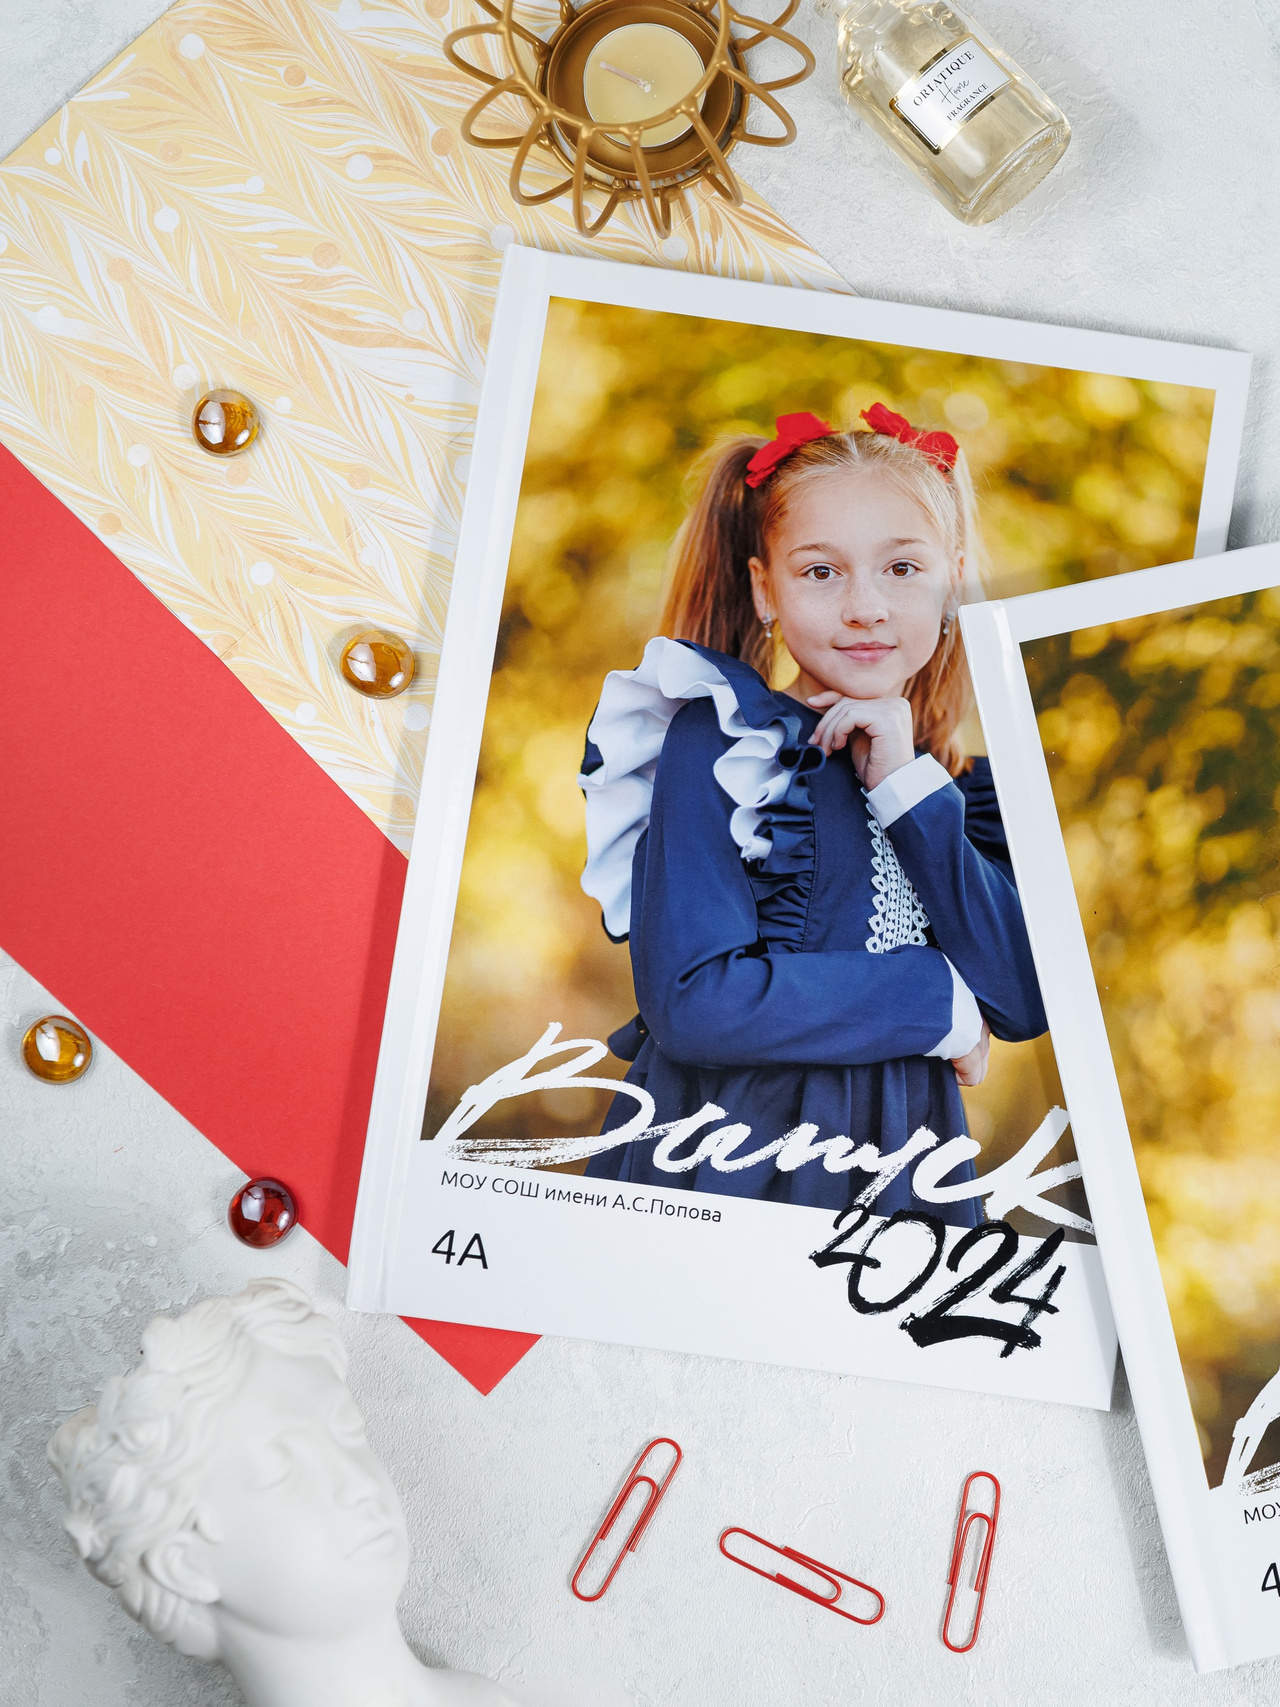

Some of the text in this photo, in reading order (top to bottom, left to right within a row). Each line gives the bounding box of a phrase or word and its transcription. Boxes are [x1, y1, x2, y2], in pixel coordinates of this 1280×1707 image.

[913, 51, 974, 106] ORIATIQUE
[938, 80, 970, 104] Home
[946, 83, 989, 121] FRAGRANCE
[441, 1170, 722, 1223] МОУ СОШ имени А.С.Попова
[431, 1229, 489, 1270] 4А
[808, 1204, 1067, 1358] 2024
